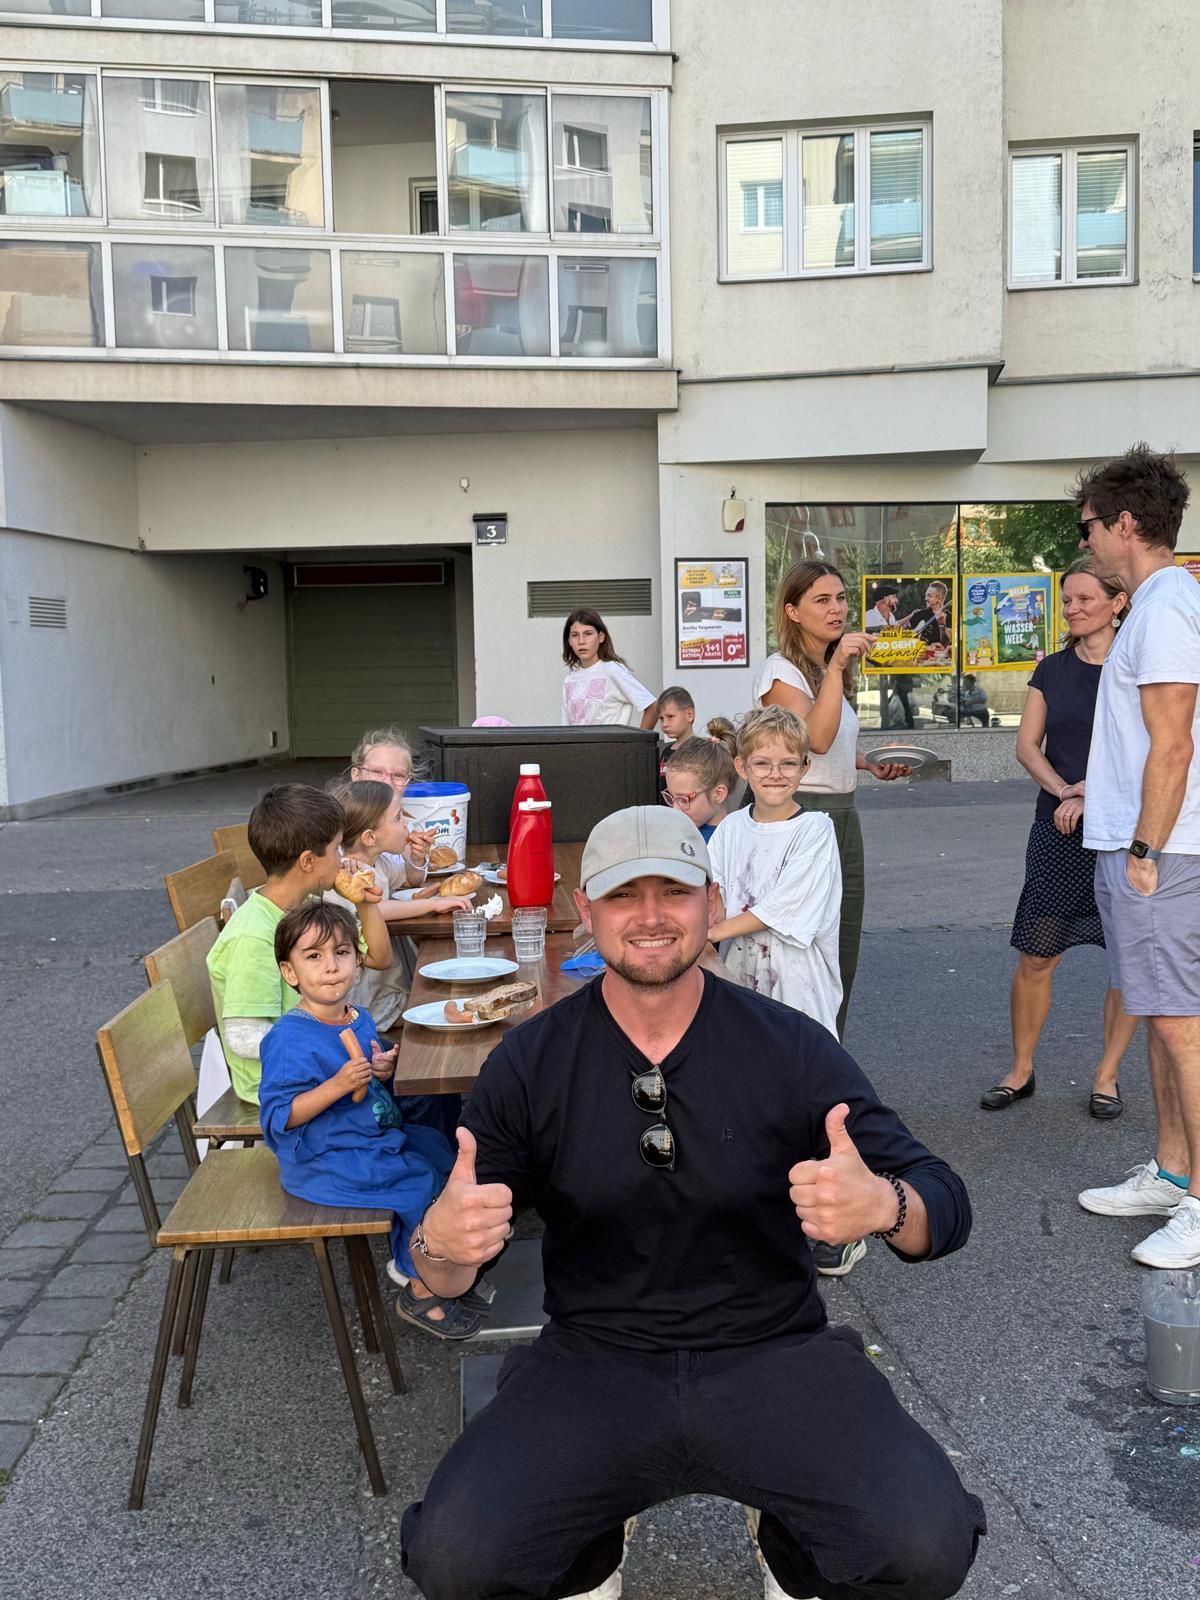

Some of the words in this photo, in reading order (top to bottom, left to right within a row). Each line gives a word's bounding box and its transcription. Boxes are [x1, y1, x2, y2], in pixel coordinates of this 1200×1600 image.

[487, 525, 497, 538] 3
[1005, 634, 1024, 645] WELT
[705, 643, 720, 652] 1+1
[876, 641, 889, 650] SO
[891, 640, 917, 649] GEHT
